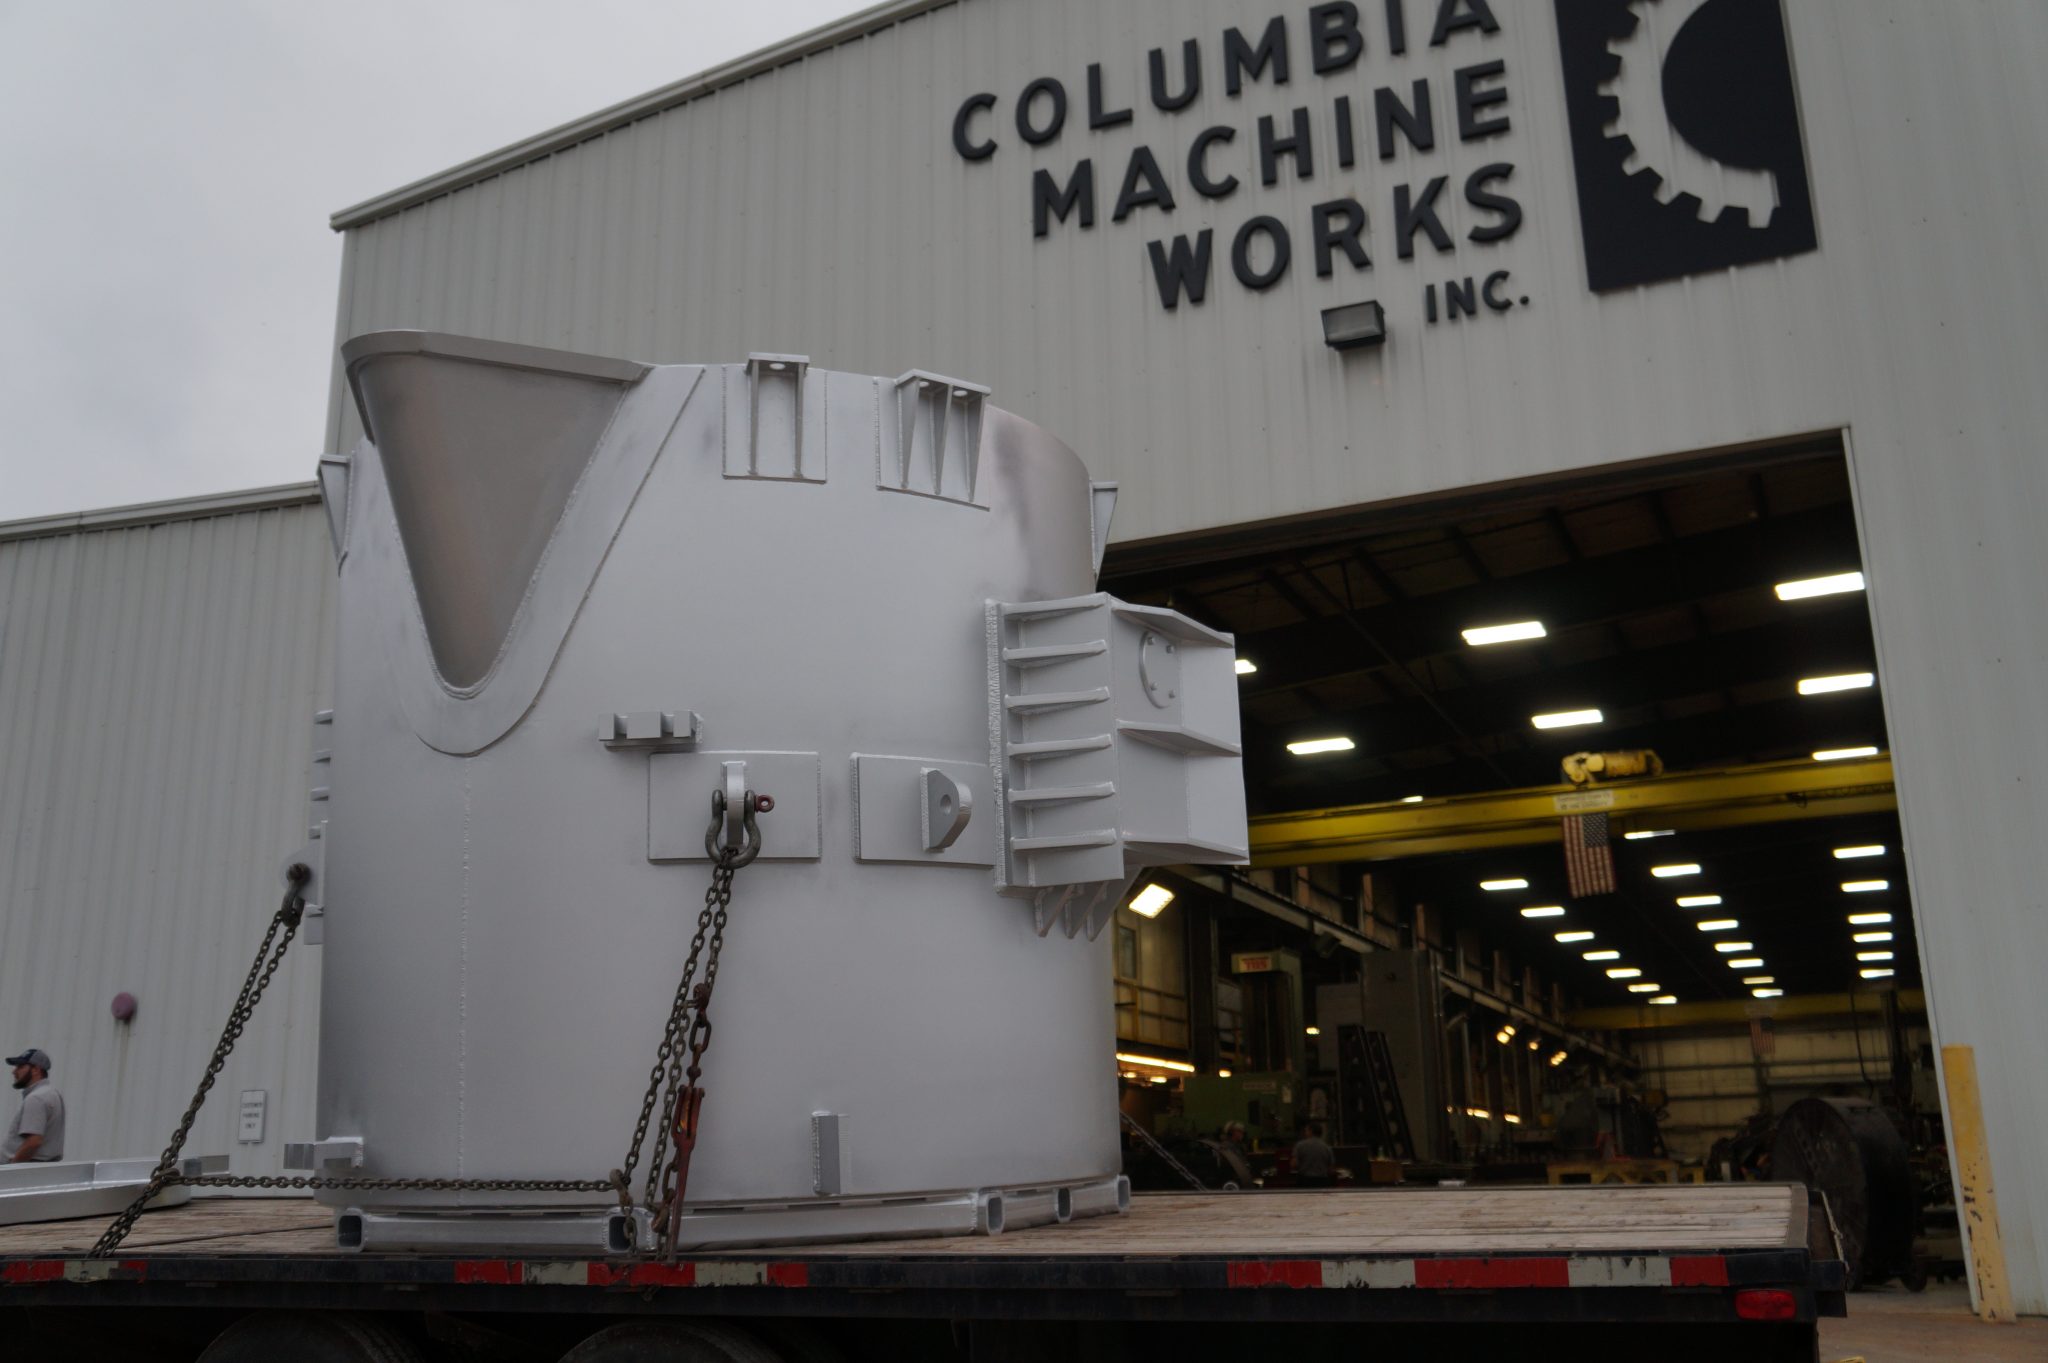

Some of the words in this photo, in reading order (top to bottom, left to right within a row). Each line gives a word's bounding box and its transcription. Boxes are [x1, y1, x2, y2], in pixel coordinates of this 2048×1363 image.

[952, 0, 1500, 162] COLUMBIA
[1032, 60, 1512, 237] MACHINE
[1147, 163, 1523, 309] WORKS
[1425, 270, 1530, 323] INC.
